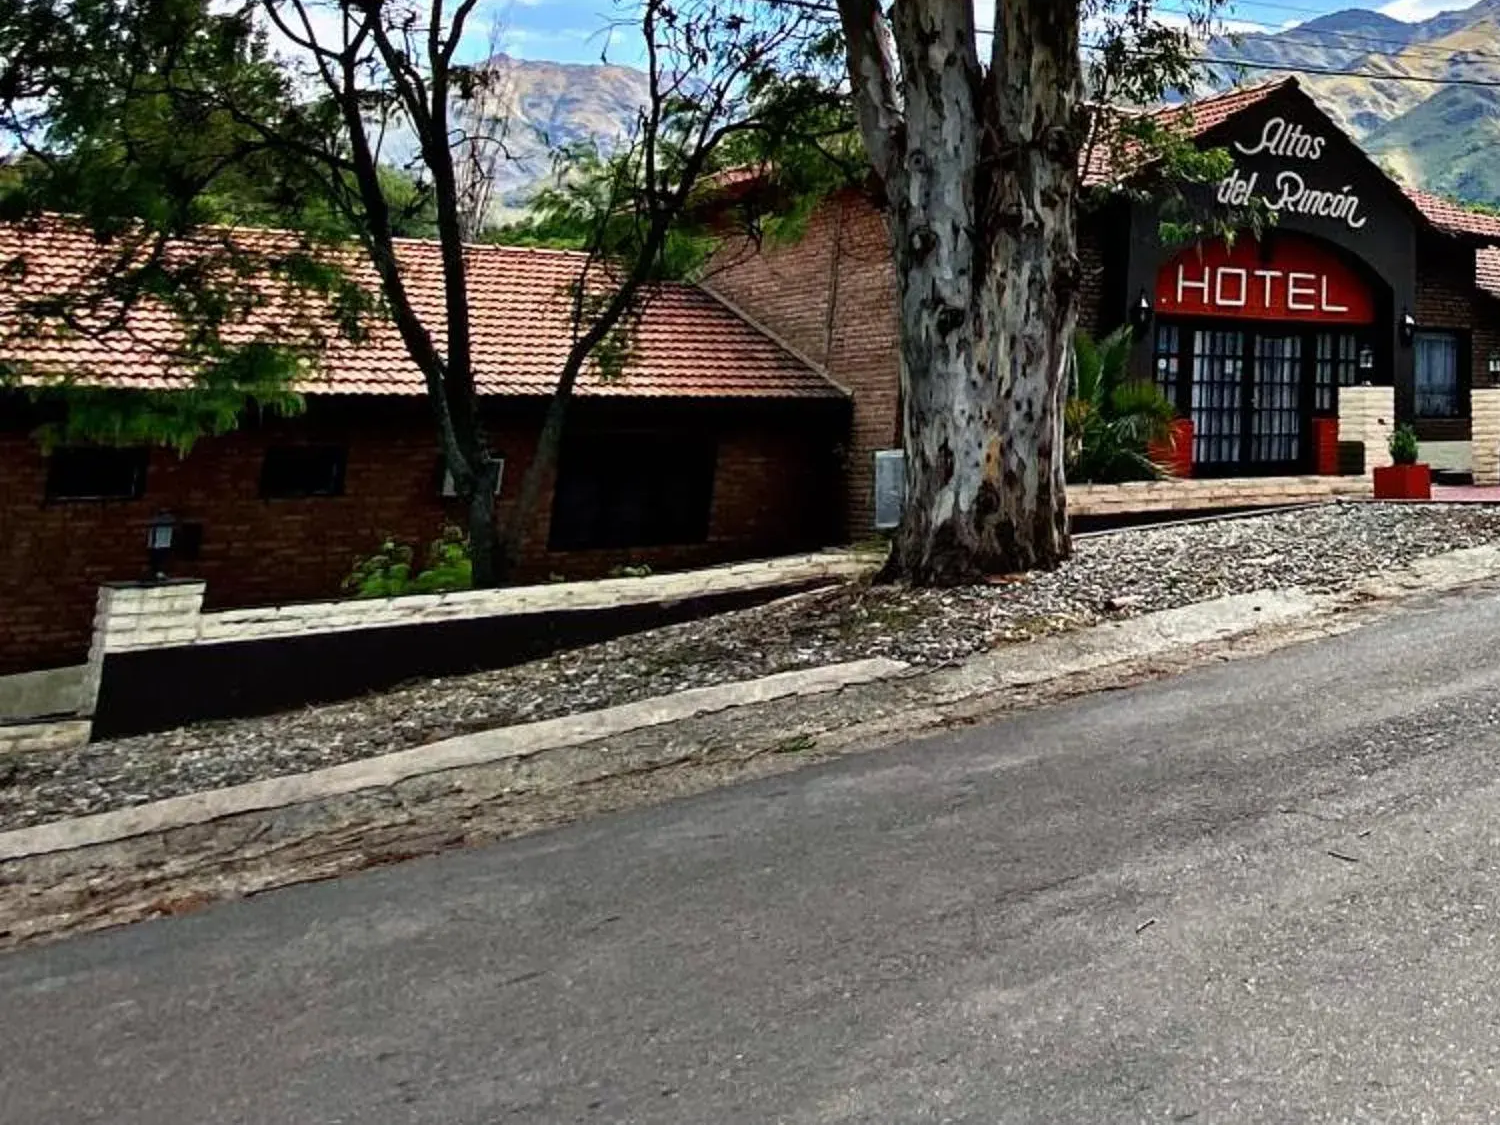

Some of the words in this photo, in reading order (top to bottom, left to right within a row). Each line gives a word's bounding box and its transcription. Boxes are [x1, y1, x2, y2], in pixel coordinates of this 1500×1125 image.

[1234, 116, 1326, 160] Altos
[1217, 169, 1258, 206] del
[1262, 171, 1367, 228] Rincón
[1177, 264, 1349, 312] HOTEL
